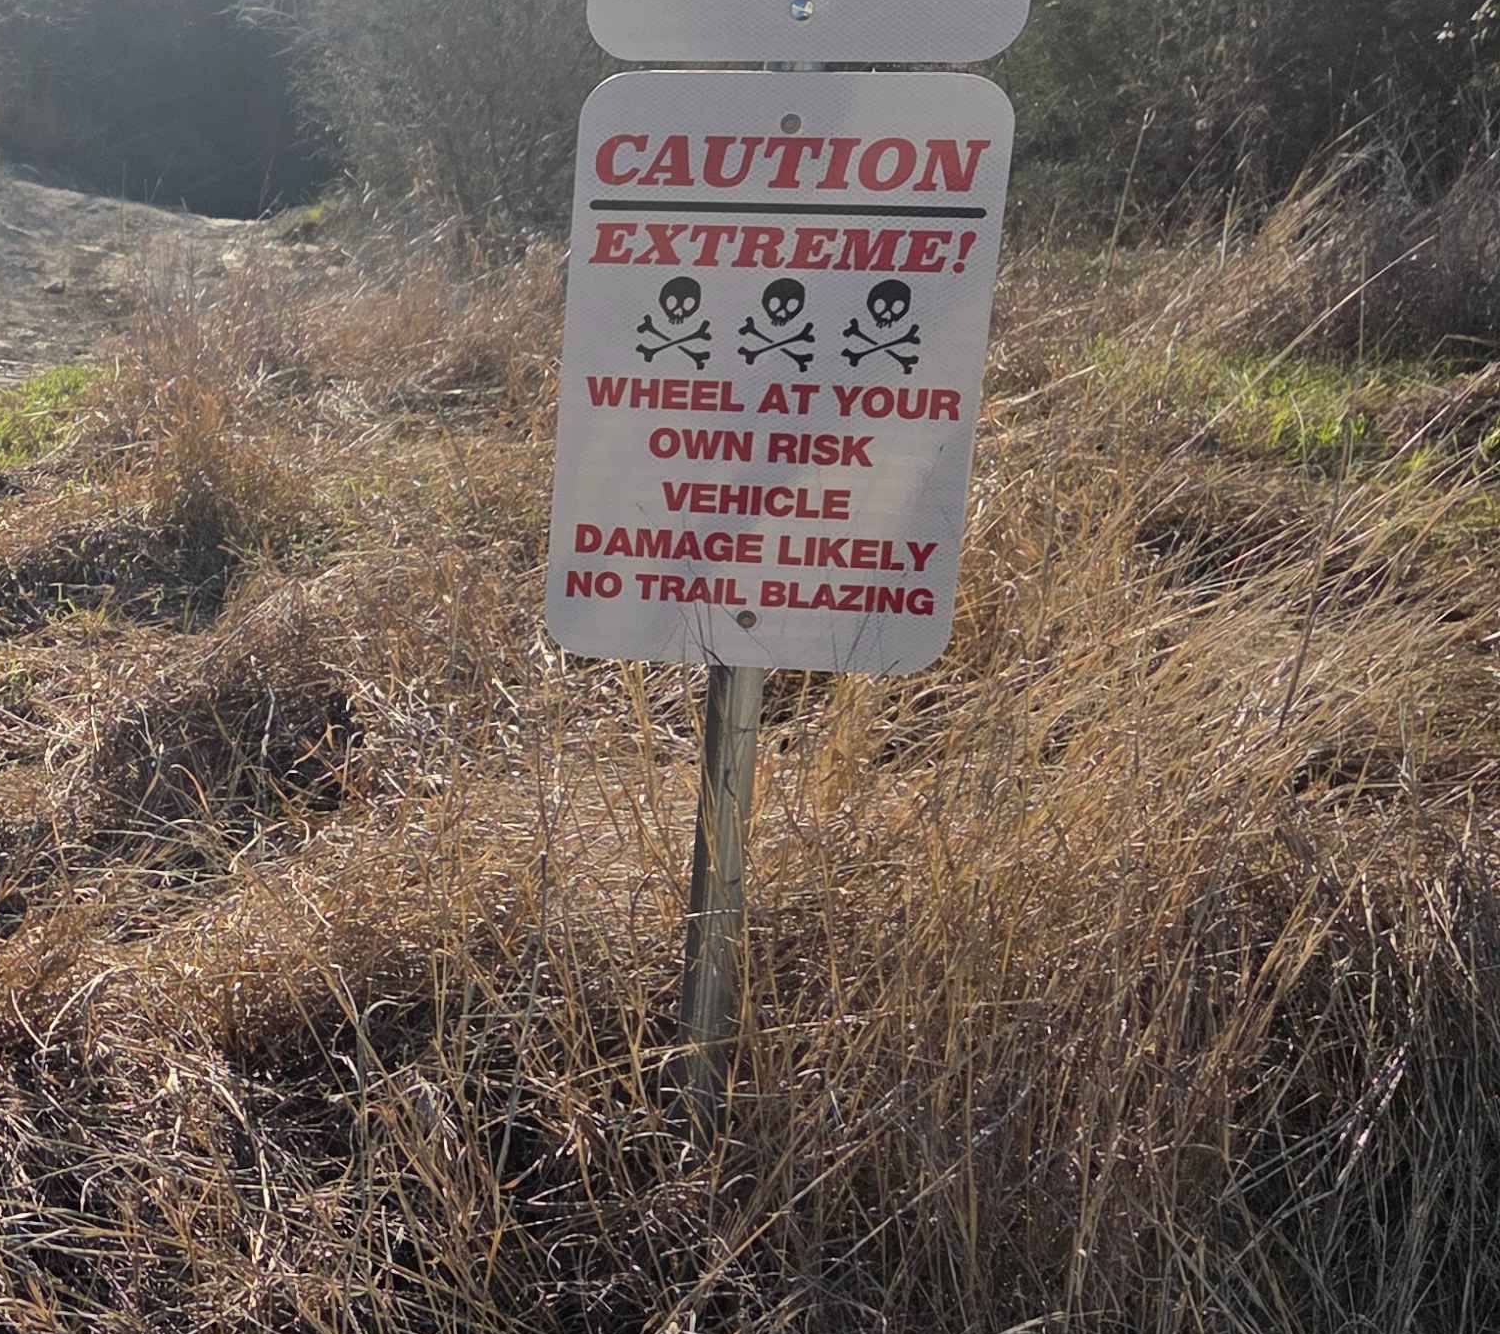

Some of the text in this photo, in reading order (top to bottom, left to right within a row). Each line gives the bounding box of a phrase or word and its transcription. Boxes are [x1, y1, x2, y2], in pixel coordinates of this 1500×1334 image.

[594, 134, 991, 193] CAUTION
[588, 222, 977, 275] EXTREME!
[587, 376, 961, 422] WHEEL AT YOUR
[648, 427, 874, 468] OWN RISK
[663, 482, 851, 520] VEHICLE
[574, 523, 938, 573] DAMAGE LIKELY
[566, 571, 935, 616] NO TRAIL BLAZING
